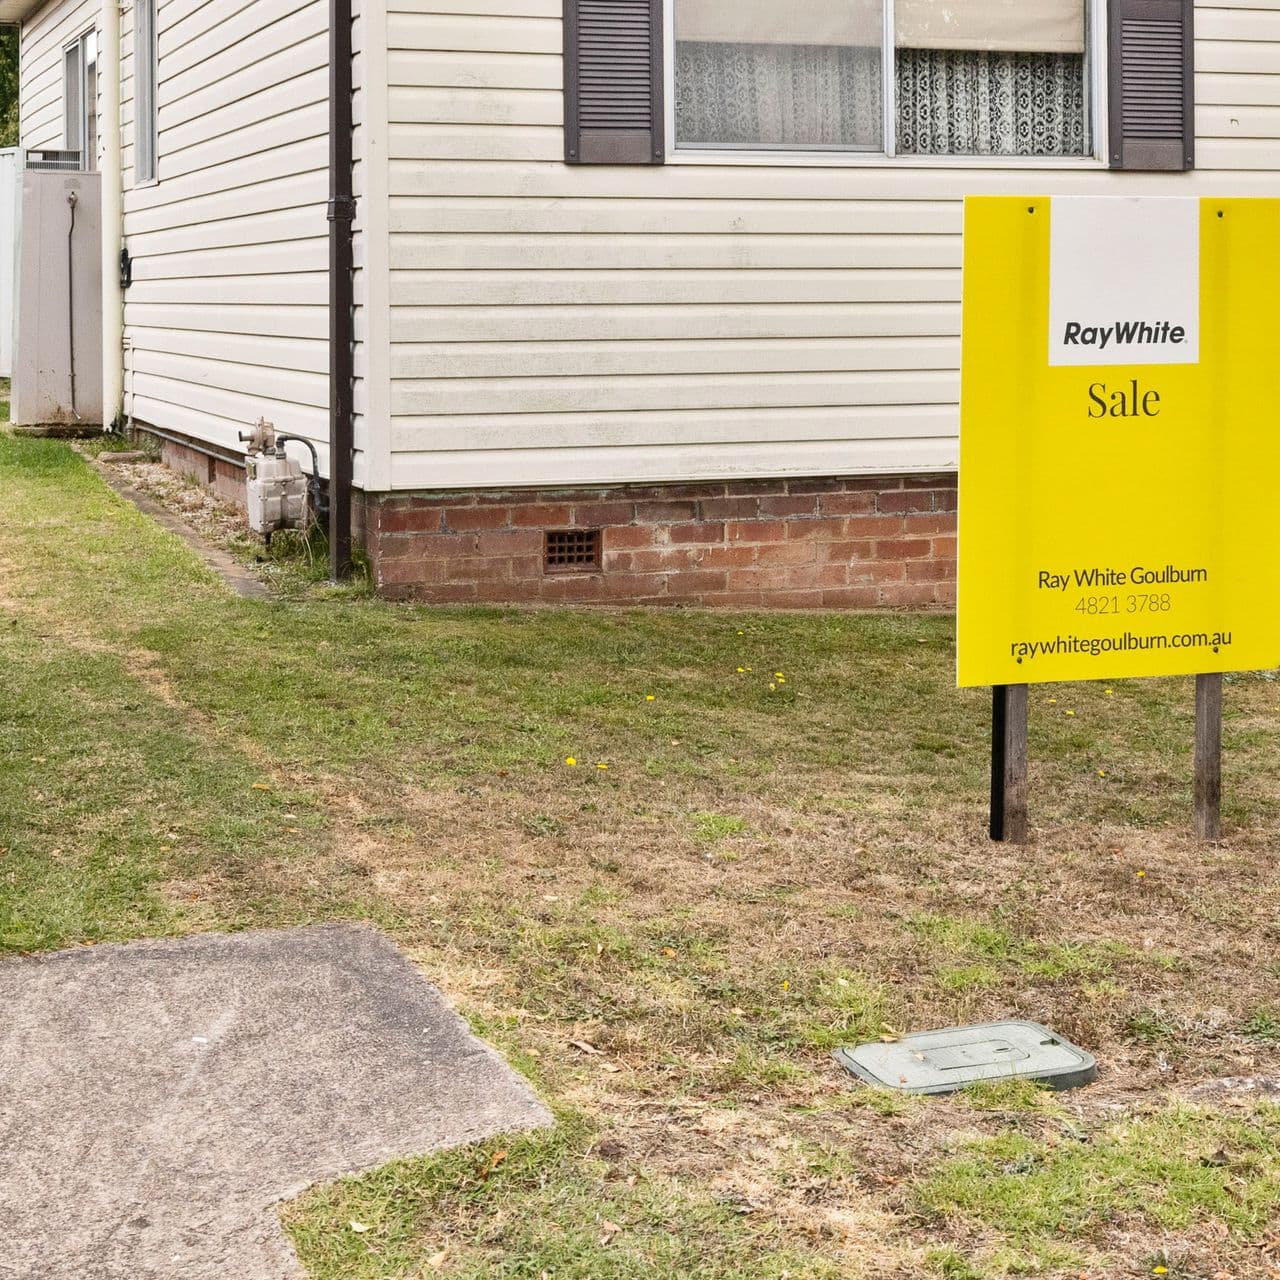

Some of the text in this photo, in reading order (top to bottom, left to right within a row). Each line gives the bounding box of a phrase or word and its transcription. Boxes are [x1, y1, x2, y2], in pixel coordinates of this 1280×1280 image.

[1087, 379, 1161, 419] Sale
[1038, 565, 1208, 592] Ray White Goulburn
[1075, 593, 1171, 615] 4821 3788
[1011, 631, 1232, 659] raywhitegoulburn.com.au
